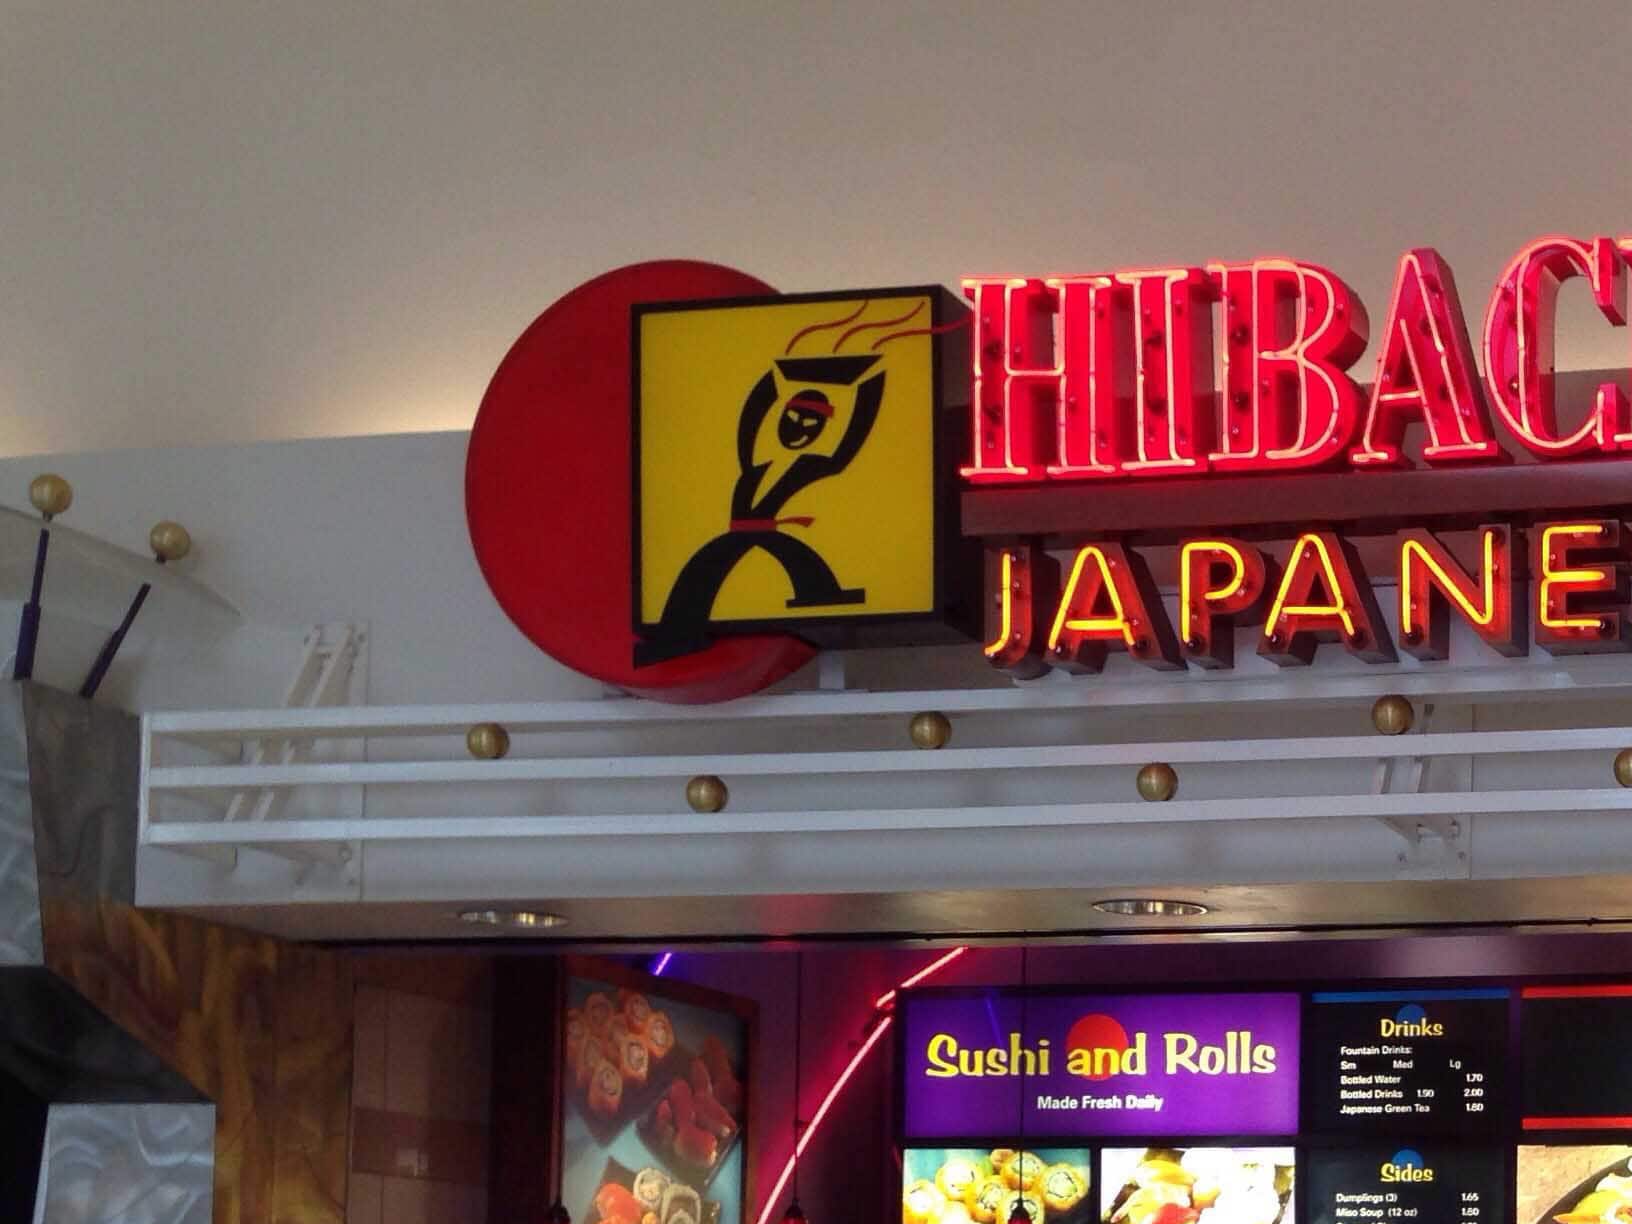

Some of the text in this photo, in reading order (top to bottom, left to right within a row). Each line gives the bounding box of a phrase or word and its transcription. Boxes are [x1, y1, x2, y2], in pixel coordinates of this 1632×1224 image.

[1380, 1017, 1444, 1037] Drinks
[925, 1031, 1277, 1078] Sushi and Rolls
[1340, 1046, 1380, 1056] Fountain
[1340, 1061, 1357, 1070] Sm
[1393, 1060, 1413, 1069] Med
[1340, 1075, 1372, 1085] Bottled
[1374, 1075, 1401, 1084] Water
[1340, 1089, 1372, 1099] Bottled
[1374, 1089, 1403, 1099] Drinks
[1037, 1094, 1163, 1111] Made Fresh Daily
[1340, 1104, 1383, 1114] Japanese
[1384, 1104, 1412, 1113] Green
[1414, 1104, 1430, 1113] Tea
[1380, 1163, 1434, 1182] Sides
[1336, 1193, 1384, 1203] Dumplings
[1336, 1208, 1358, 1217] Miso
[1359, 1208, 1384, 1218] Soup
